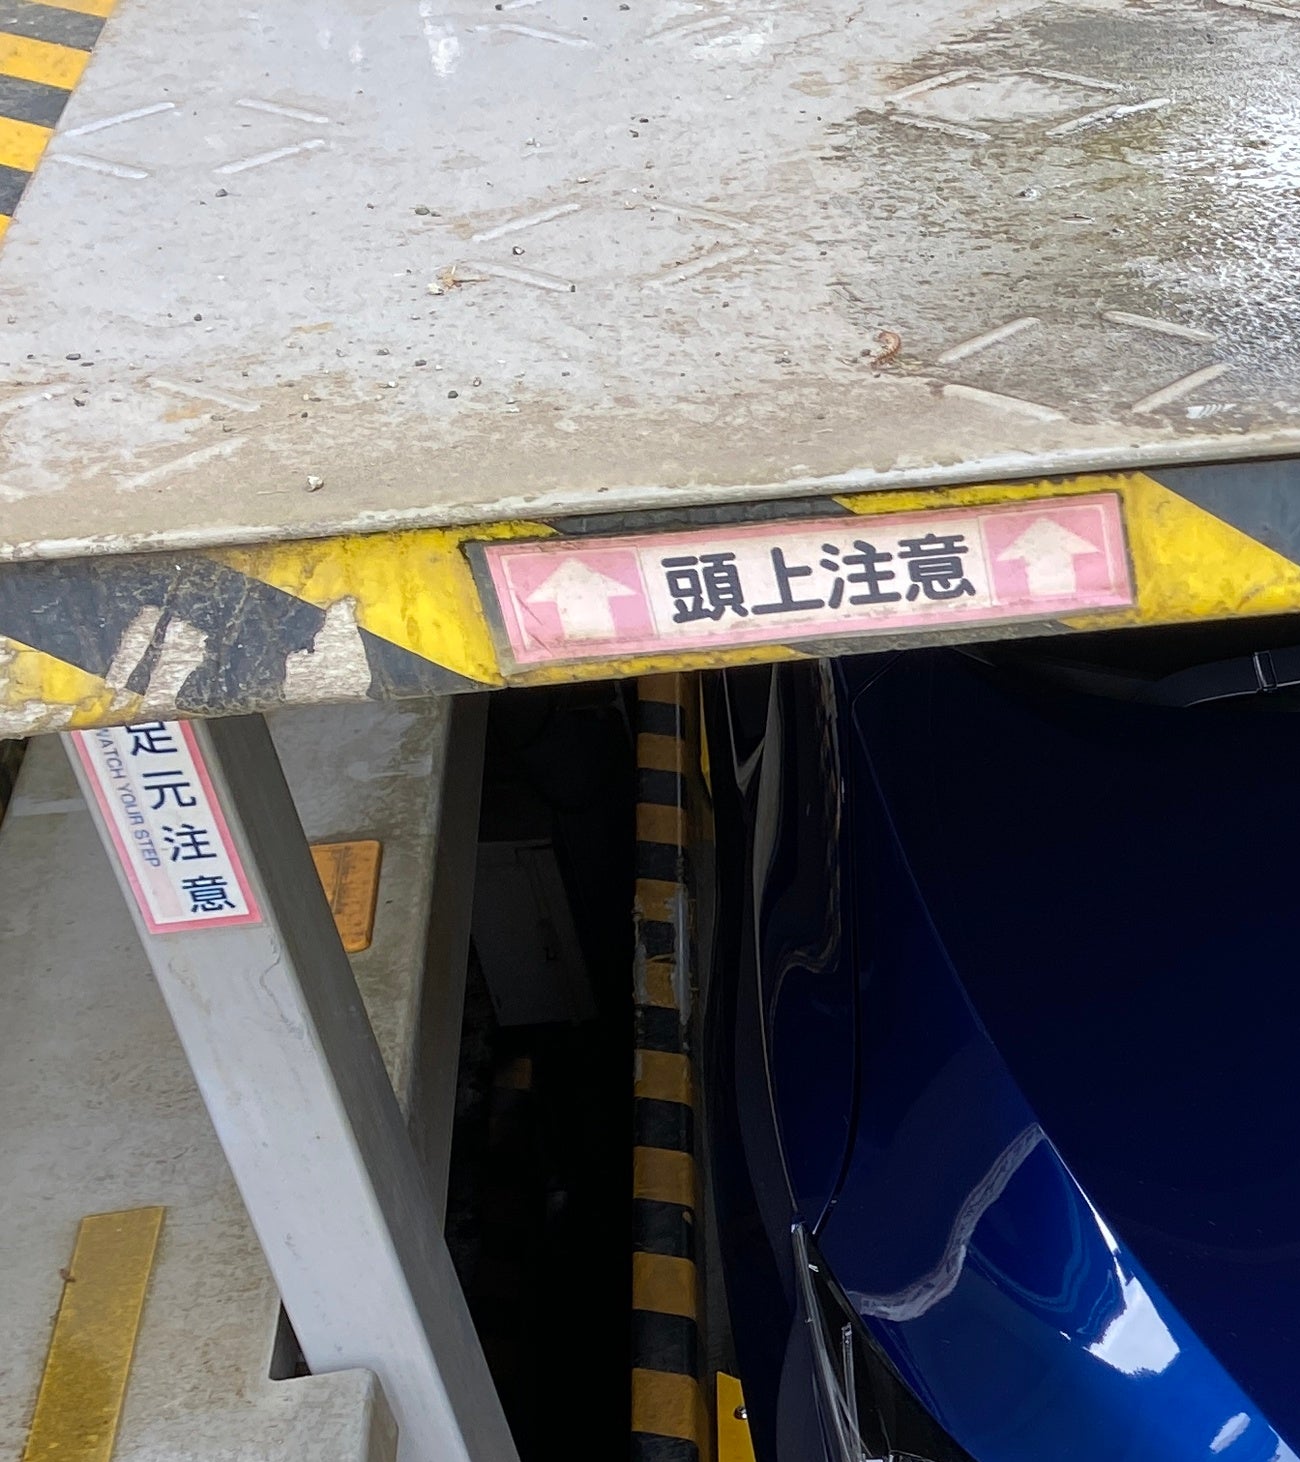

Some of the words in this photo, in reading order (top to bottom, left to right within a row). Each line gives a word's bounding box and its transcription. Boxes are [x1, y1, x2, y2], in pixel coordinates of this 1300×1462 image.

[660, 532, 977, 624] 頭上注意
[117, 782, 145, 826] YOUR
[134, 829, 161, 868] STEP
[125, 721, 237, 913] 足元注意
